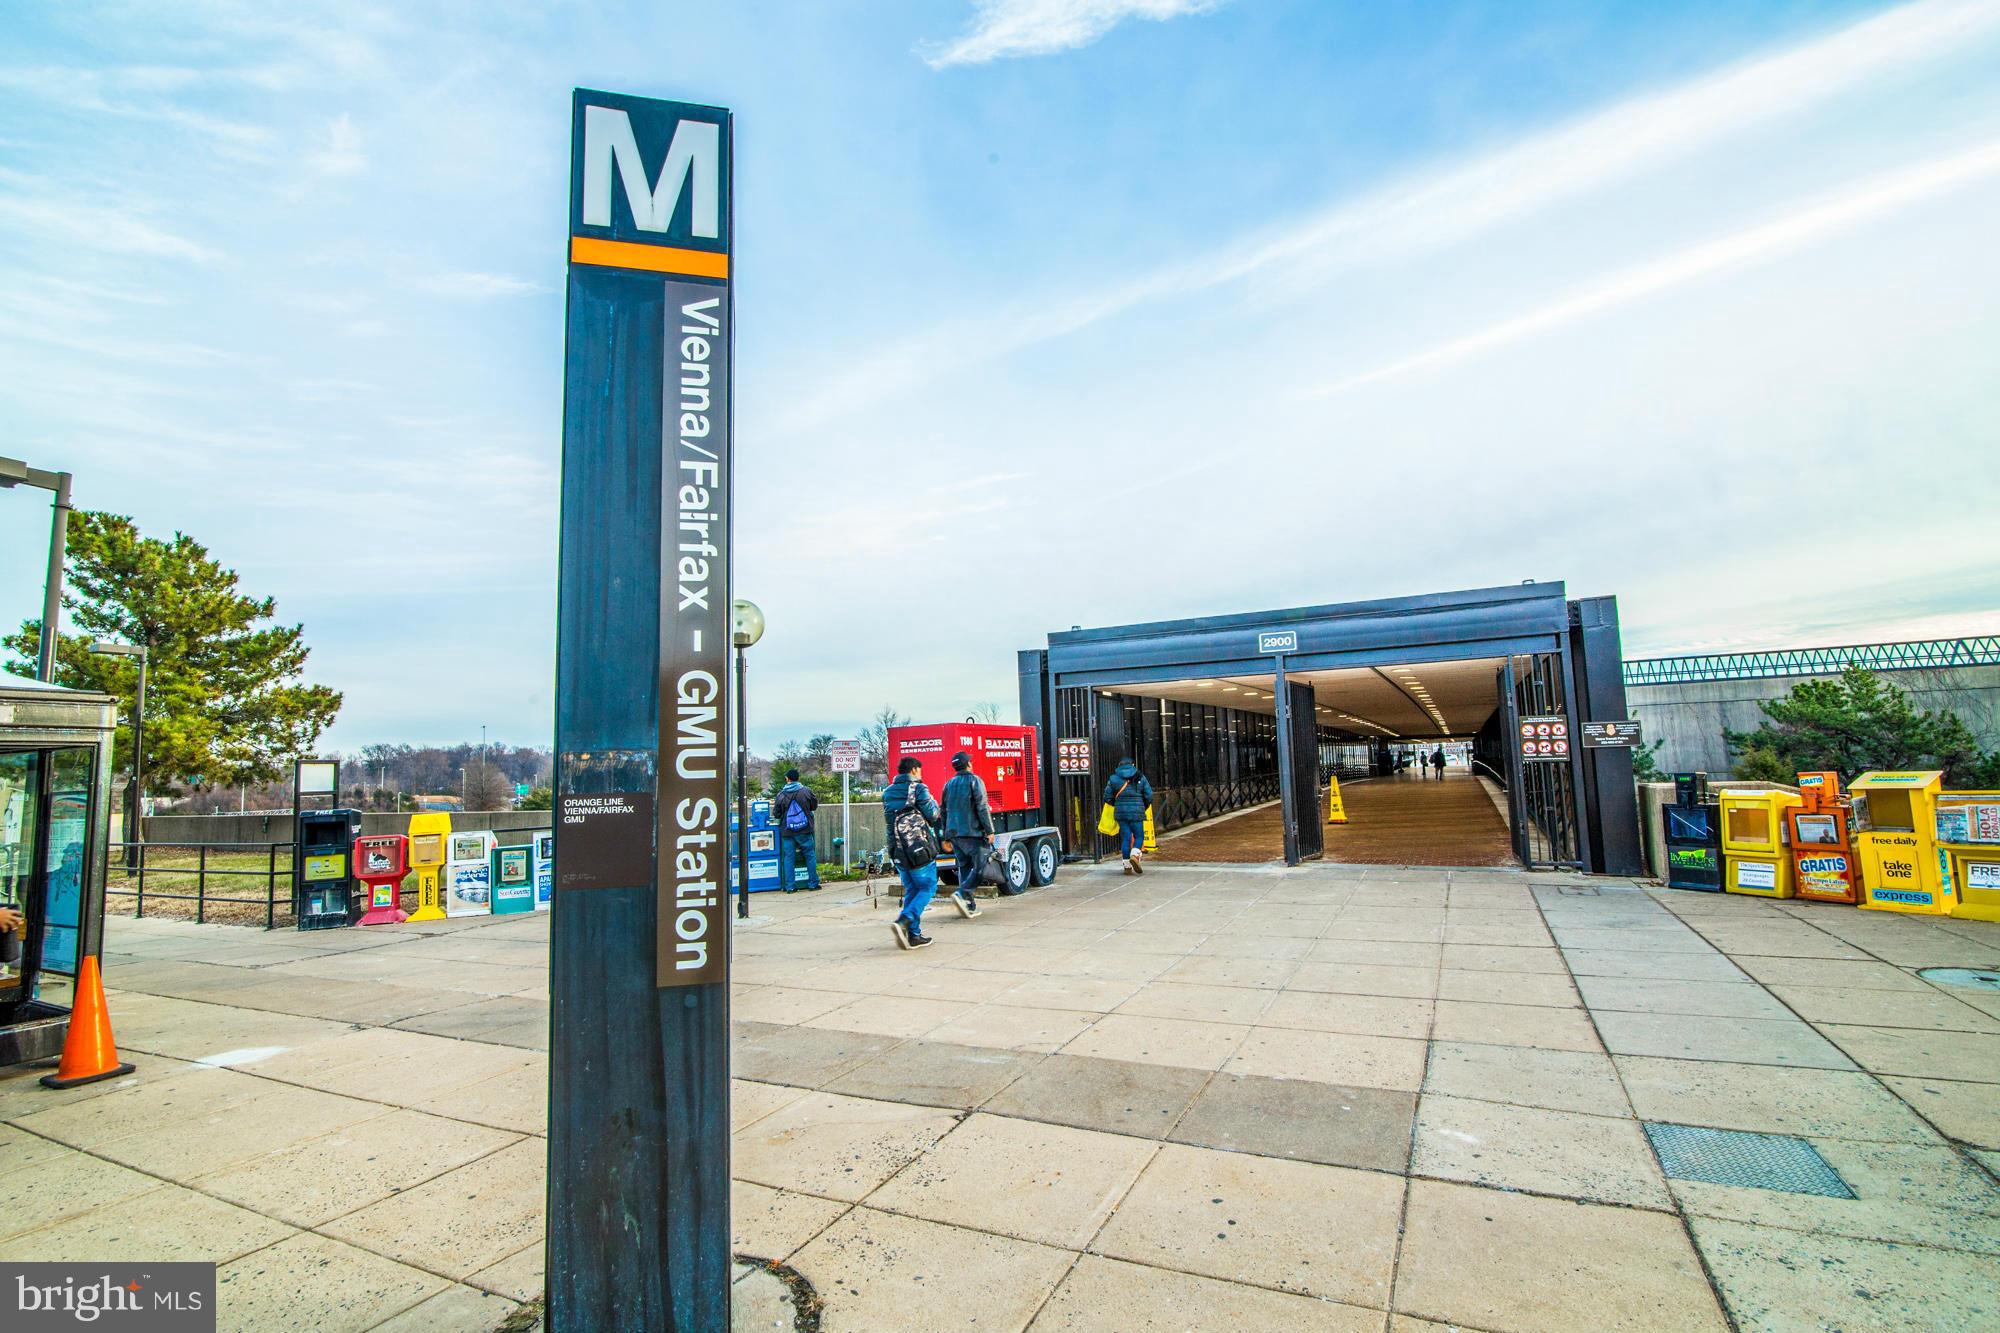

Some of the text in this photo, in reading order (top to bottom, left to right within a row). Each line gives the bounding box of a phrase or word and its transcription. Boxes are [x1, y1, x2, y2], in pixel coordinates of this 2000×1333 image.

[583, 105, 720, 239] M
[678, 297, 720, 612] Vienna/Fairfax
[1263, 636, 1292, 647] 2900
[676, 670, 719, 780] GMU
[900, 739, 943, 748] BALDOR
[985, 739, 1021, 749] BALDOR
[1800, 776, 1823, 785] GRATIS
[564, 797, 624, 807] ORANGE LINE
[564, 805, 634, 815] VIENNA/FAIRFAX
[564, 816, 585, 824] GMU
[1979, 807, 1991, 839] HOLA
[1871, 837, 1918, 846] free daily
[1800, 857, 1847, 873] GRATIS
[1883, 860, 1912, 871] take
[1886, 870, 1912, 878] one
[675, 797, 718, 970] Station
[1874, 890, 1930, 903] express
